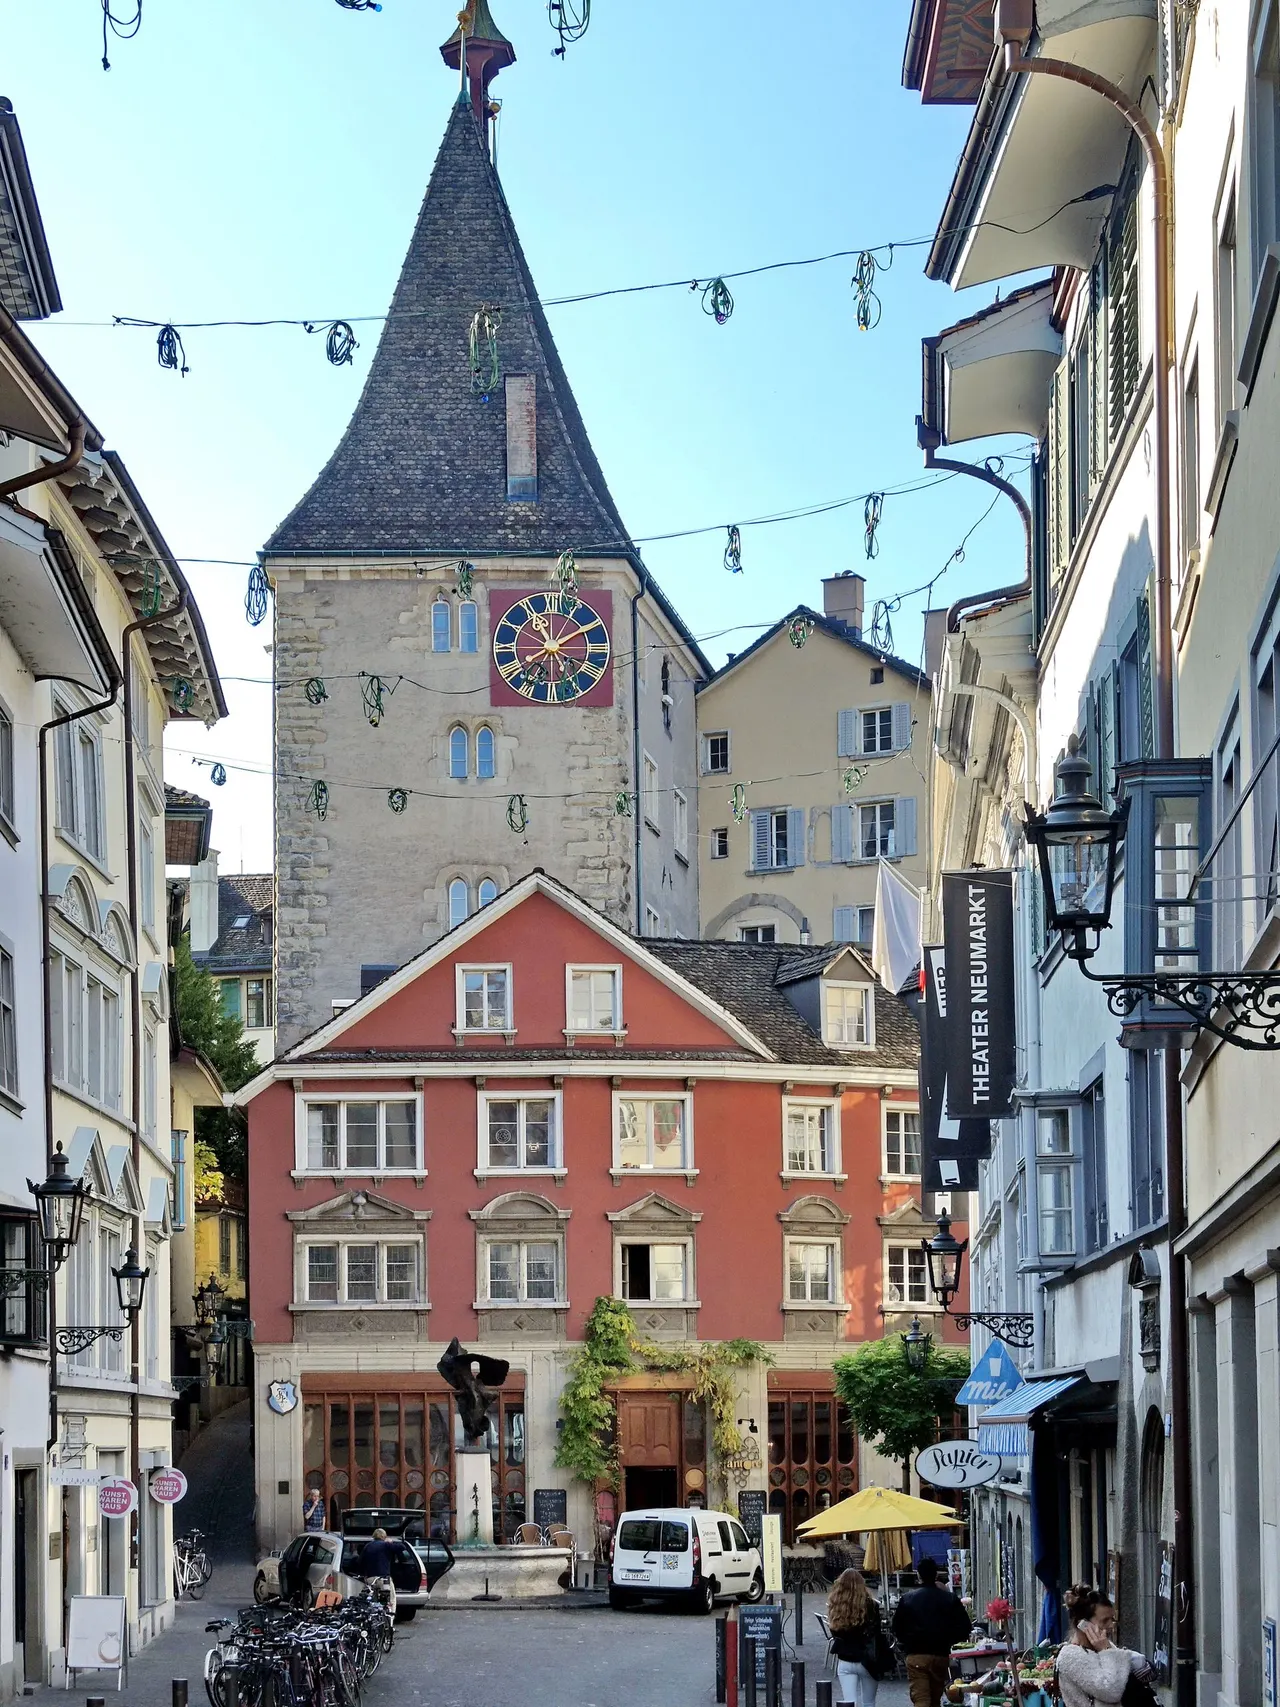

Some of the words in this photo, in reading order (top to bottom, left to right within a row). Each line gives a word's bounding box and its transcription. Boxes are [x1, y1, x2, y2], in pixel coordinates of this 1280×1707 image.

[968, 884, 988, 1003] NEUMARKT
[971, 1008, 989, 1105] THEATER
[926, 1447, 993, 1483] Papier
[99, 1490, 127, 1498] KUNST
[99, 1496, 128, 1505] WAREN
[99, 1502, 121, 1510] HAUS
